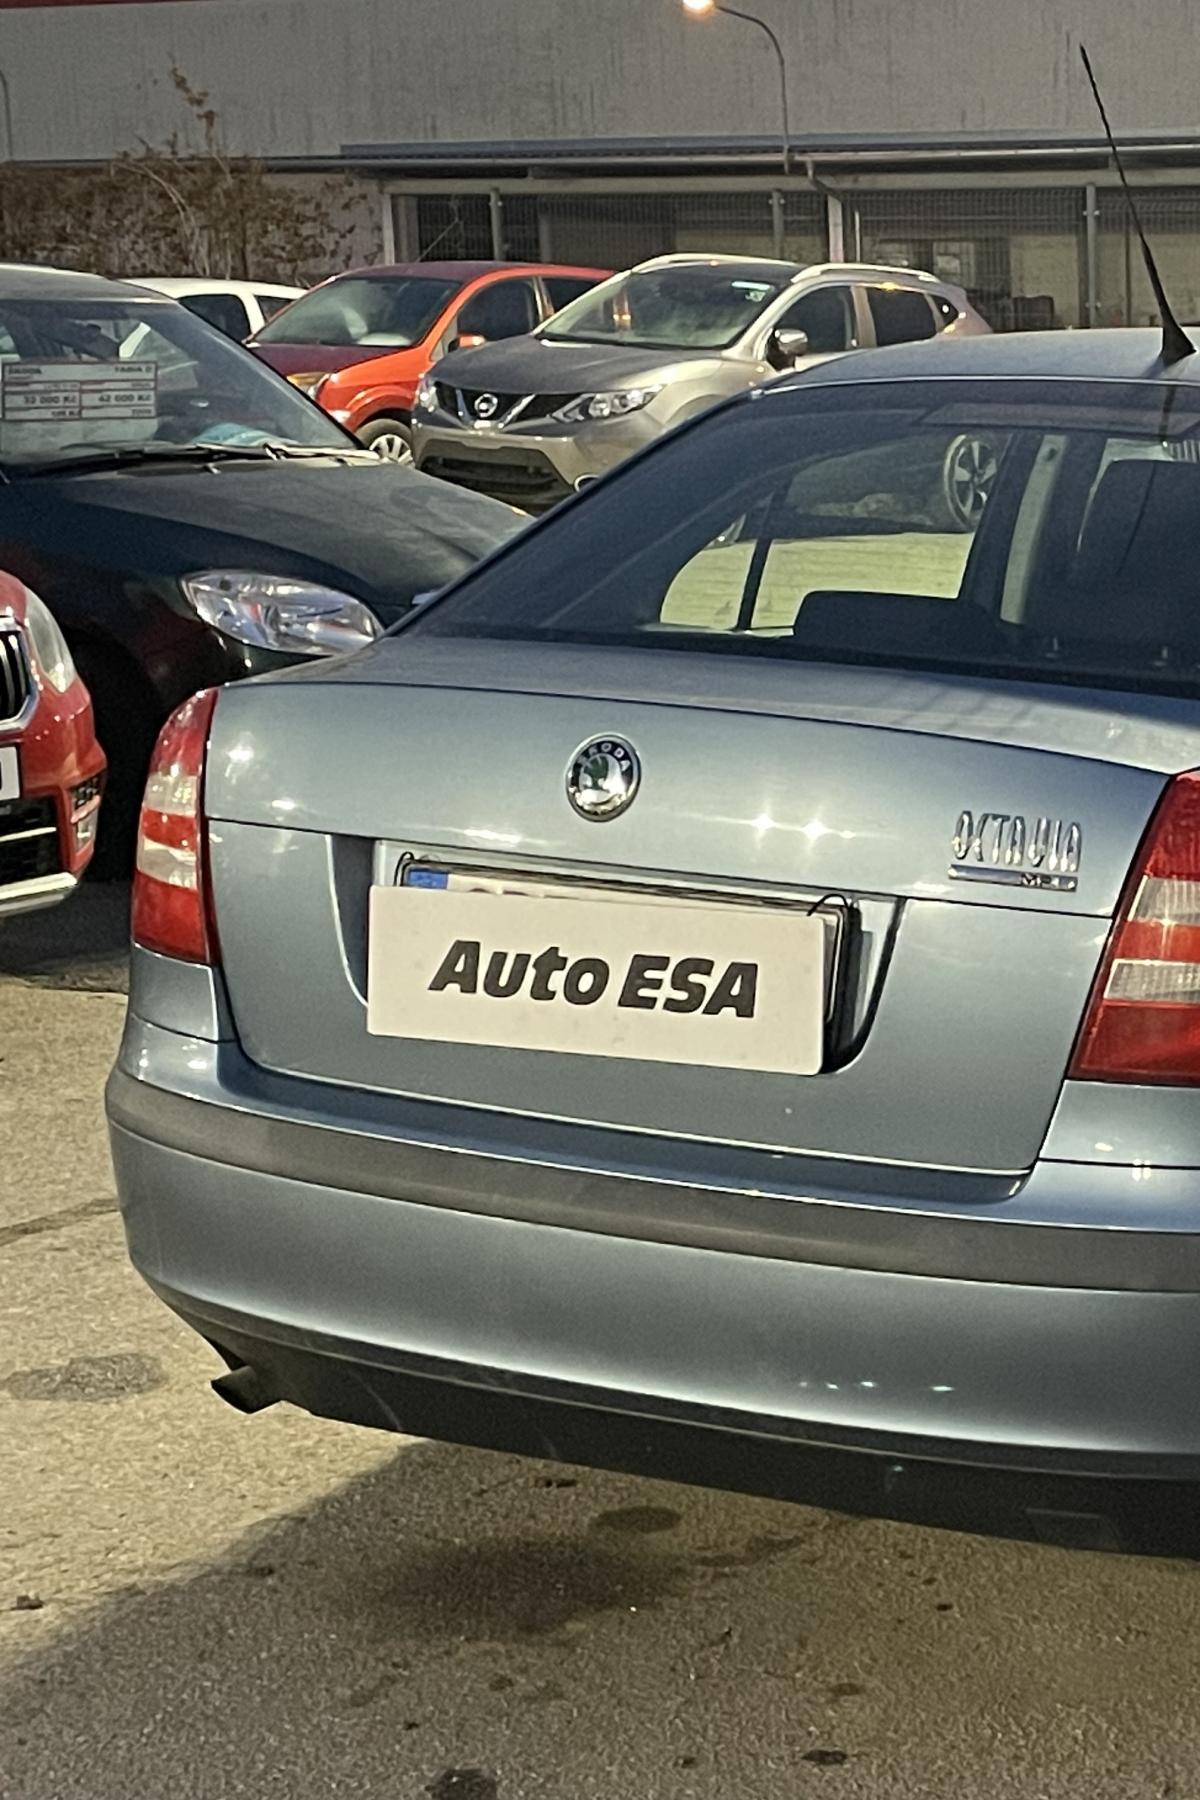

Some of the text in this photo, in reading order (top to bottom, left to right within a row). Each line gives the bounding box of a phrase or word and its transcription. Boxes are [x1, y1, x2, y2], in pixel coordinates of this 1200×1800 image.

[951, 810, 1082, 873] OCTAVIA
[428, 939, 759, 1018] Auto ESA
